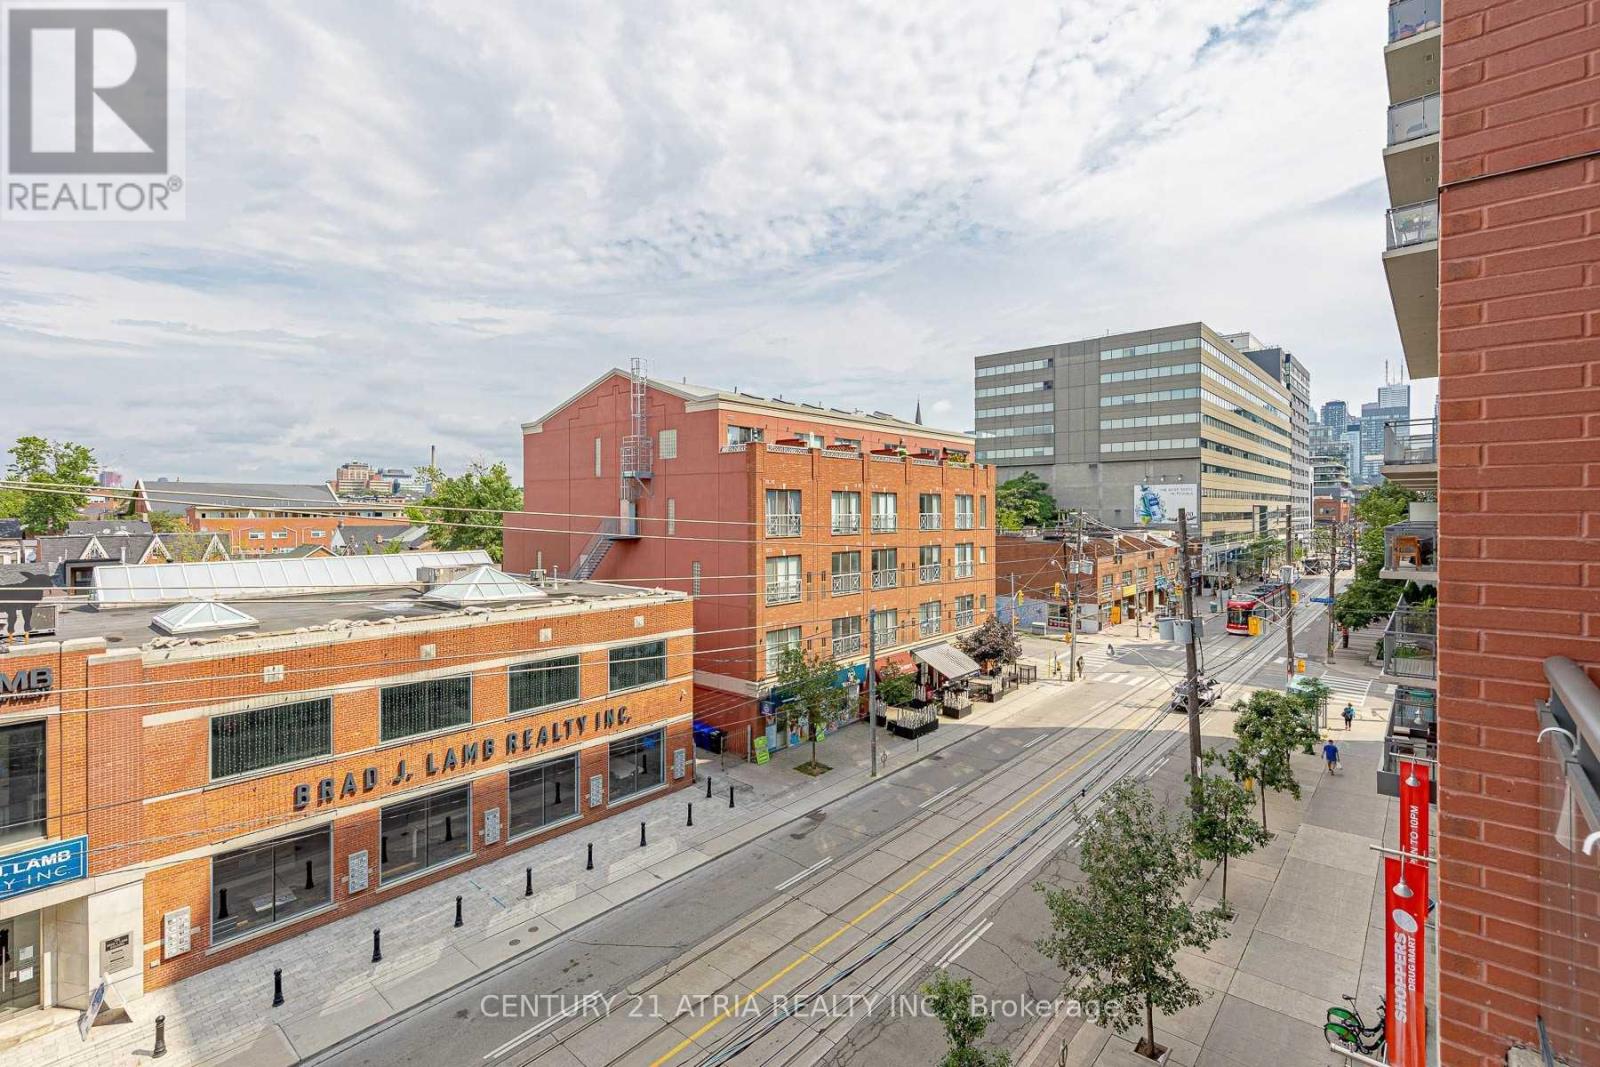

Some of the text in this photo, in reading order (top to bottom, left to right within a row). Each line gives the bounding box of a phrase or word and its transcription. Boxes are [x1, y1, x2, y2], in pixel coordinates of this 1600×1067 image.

[294, 705, 632, 811] BRAD J. LAMB REALTY INC.
[1410, 805, 1419, 829] 10PM
[1410, 831, 1419, 845] TO
[13, 849, 71, 874] LAMB
[28, 865, 71, 884] INC.
[1408, 936, 1416, 992] DRUG MART
[1394, 931, 1407, 1024] SHOPPERS
